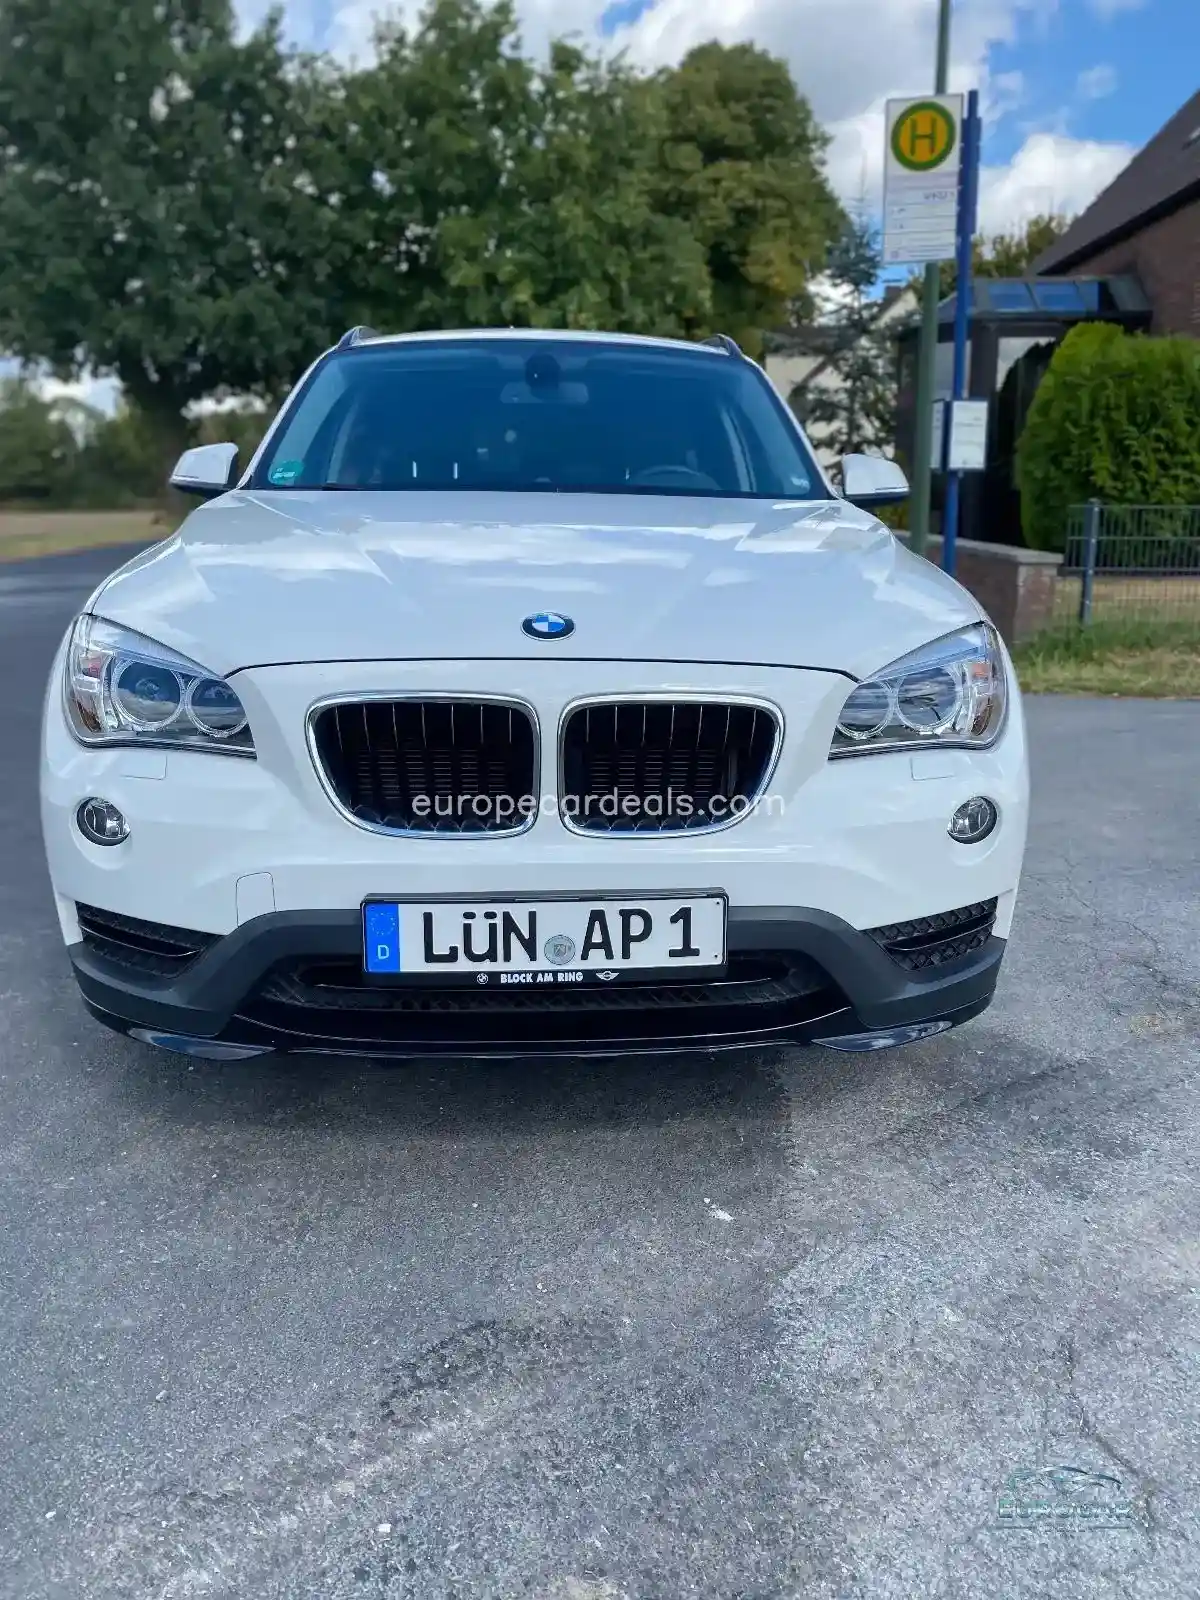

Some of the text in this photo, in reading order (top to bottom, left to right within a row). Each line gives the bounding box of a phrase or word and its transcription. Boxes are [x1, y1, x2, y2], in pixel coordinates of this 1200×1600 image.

[910, 116, 937, 156] H
[580, 907, 653, 960] AP
[668, 906, 700, 958] 1
[377, 944, 390, 960] D
[500, 971, 584, 984] BLOCK AM RING
